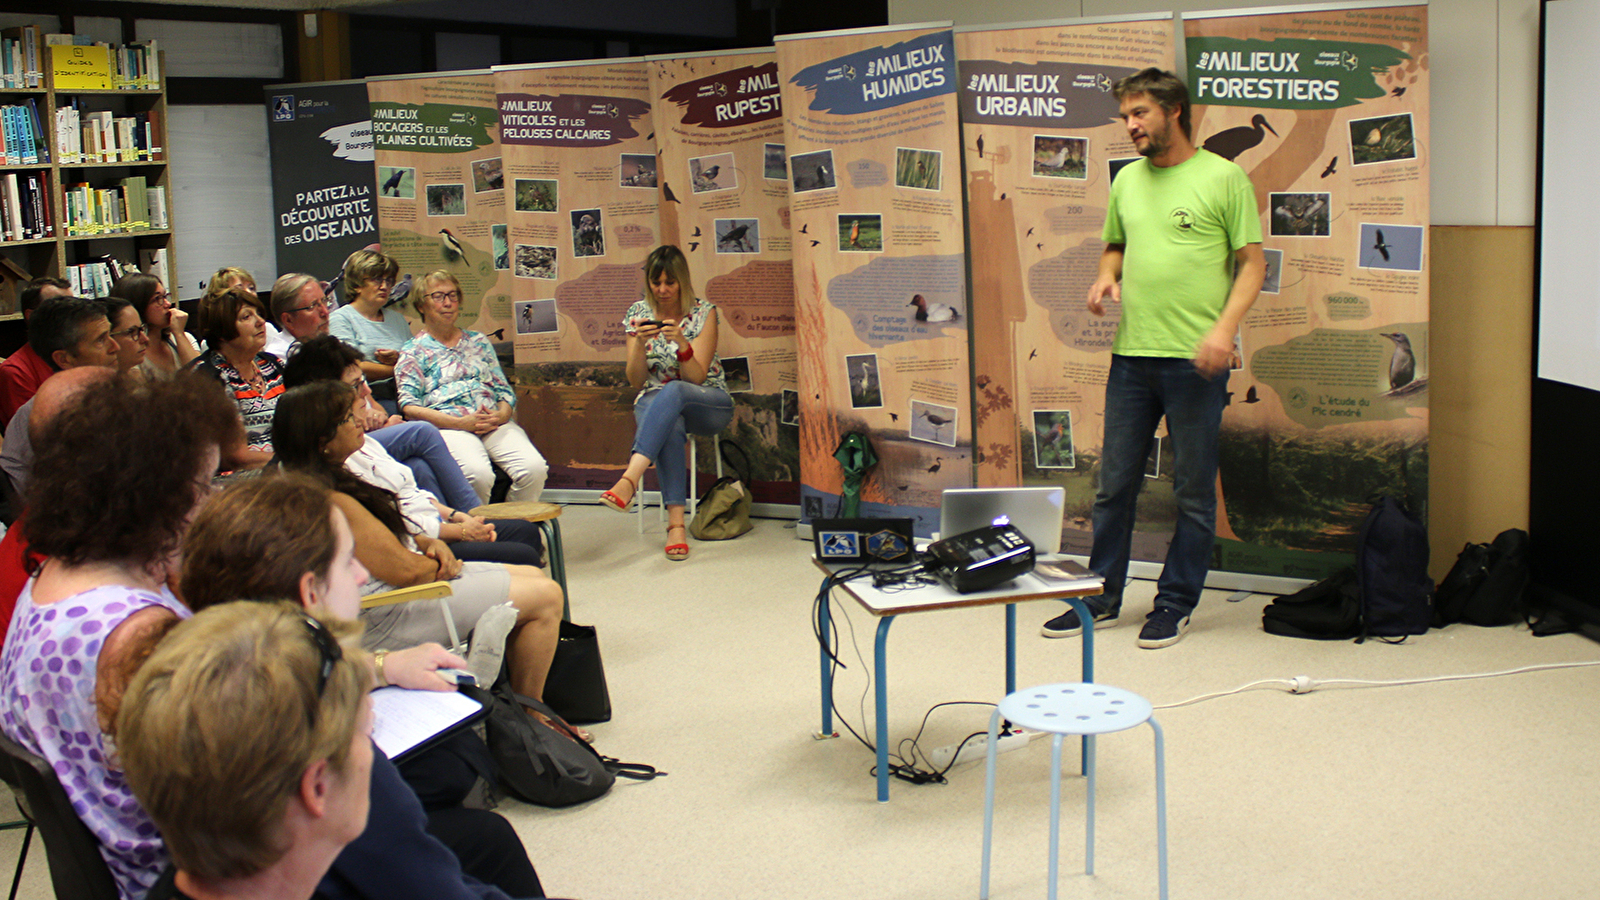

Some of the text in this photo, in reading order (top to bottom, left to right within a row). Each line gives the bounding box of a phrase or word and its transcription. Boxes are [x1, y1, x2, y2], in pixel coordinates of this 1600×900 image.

[865, 61, 875, 77] les
[876, 44, 945, 76] MILIEUX
[1195, 51, 1300, 73] les MILIEUX
[737, 79, 747, 94] les
[862, 67, 945, 102] HUMIDES
[967, 73, 1060, 94] les MILIEUX
[1198, 76, 1340, 101] FORESTIERS
[506, 101, 552, 112] MILIEUX
[715, 93, 780, 122] RUPEST
[976, 96, 1067, 117] URBAINS
[378, 109, 418, 120] MILIEUX
[502, 114, 557, 126] VITICOLES
[570, 119, 586, 127] LES
[373, 122, 449, 134] BOCAGERS ET LES
[503, 128, 611, 140] PELOUSES CALCAIRES
[376, 133, 473, 147] PLAINES CULTIVÉES
[296, 185, 370, 207] PARTEZ À LA
[281, 198, 371, 227] DÉCOUVERTE
[1067, 206, 1083, 214] 200
[284, 214, 375, 245] DES OISEAUX
[873, 314, 907, 326] Comptage
[1319, 395, 1370, 407] L'étude du
[1329, 407, 1362, 417] cendré
